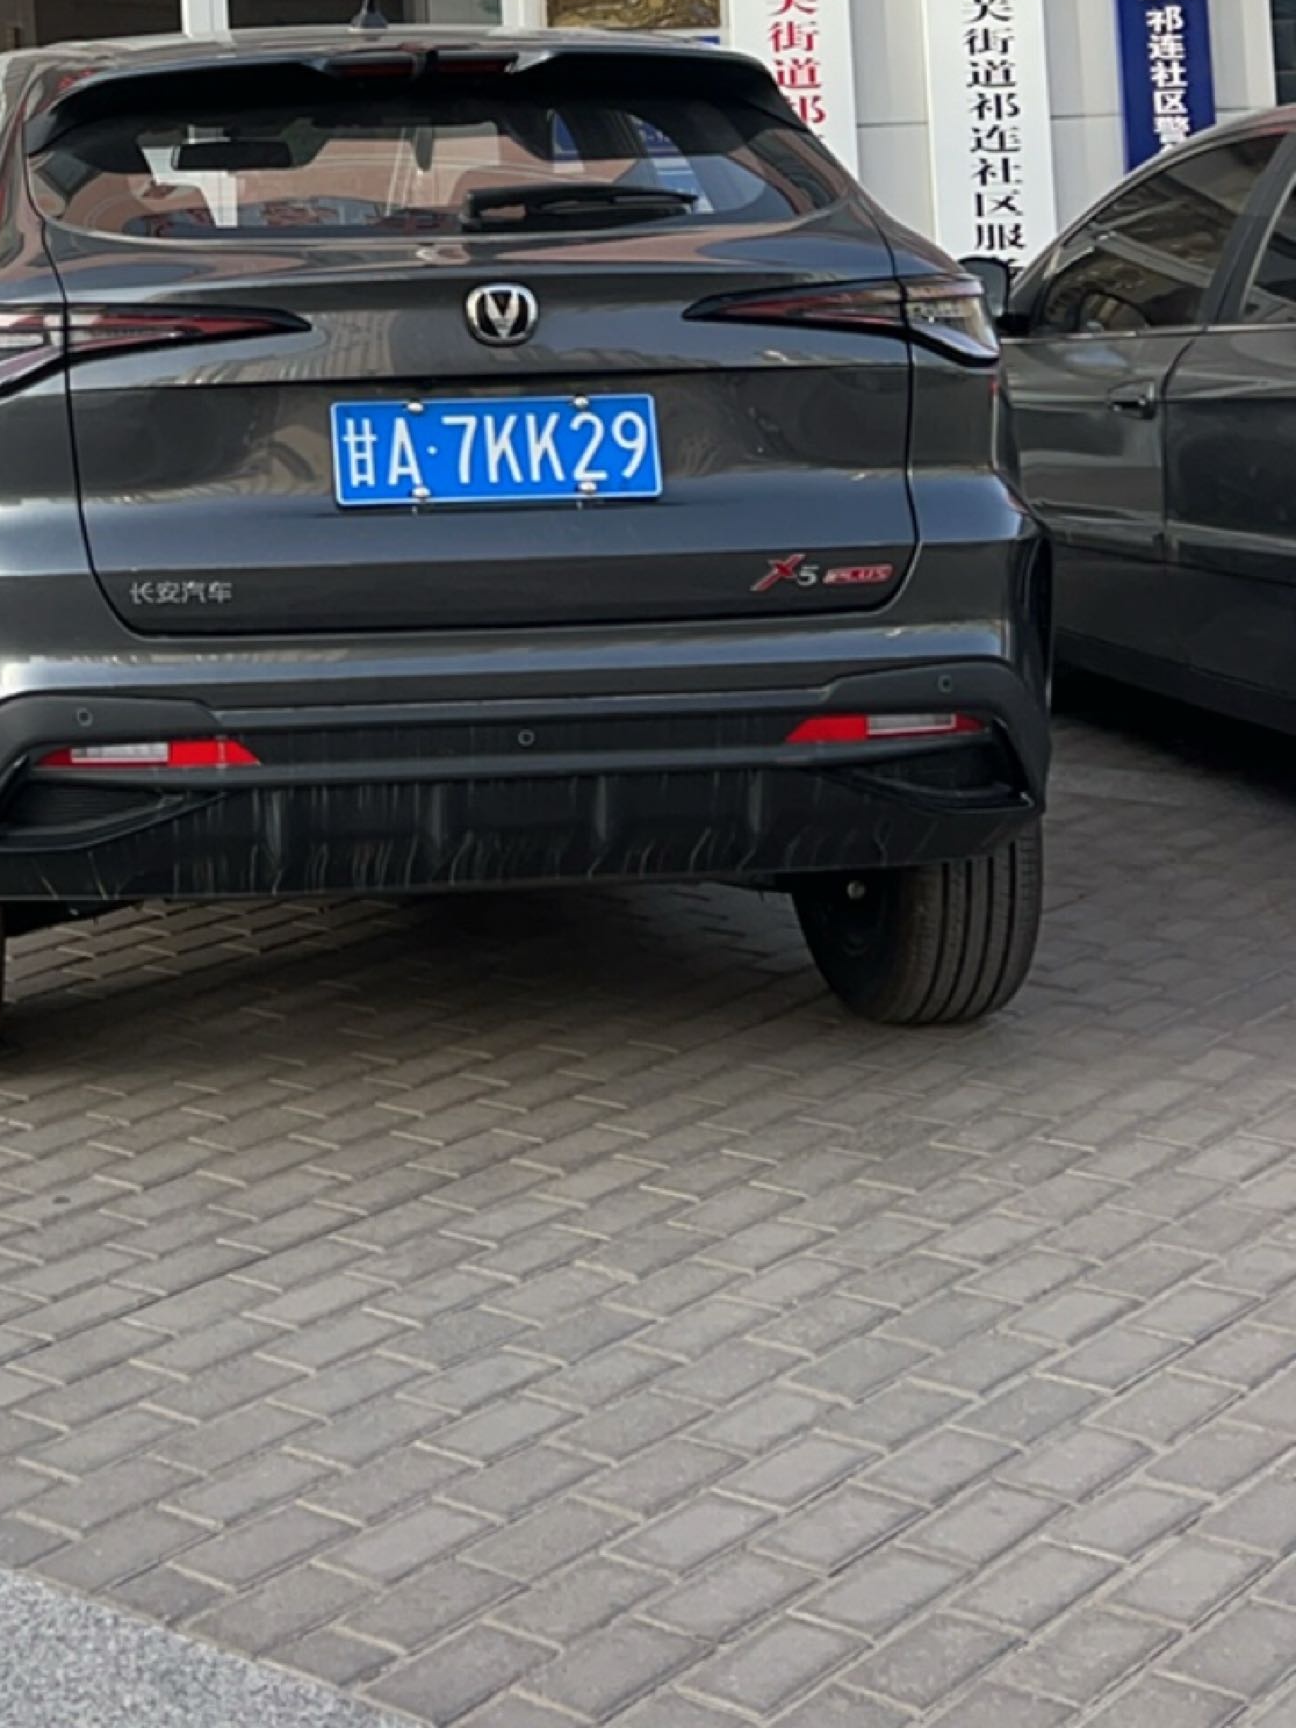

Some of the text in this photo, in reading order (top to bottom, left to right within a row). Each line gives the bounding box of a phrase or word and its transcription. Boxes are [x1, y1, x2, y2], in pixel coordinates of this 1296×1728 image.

[1144, 5, 1190, 153] 祁连社区警
[129, 580, 233, 605] 长安汽车
